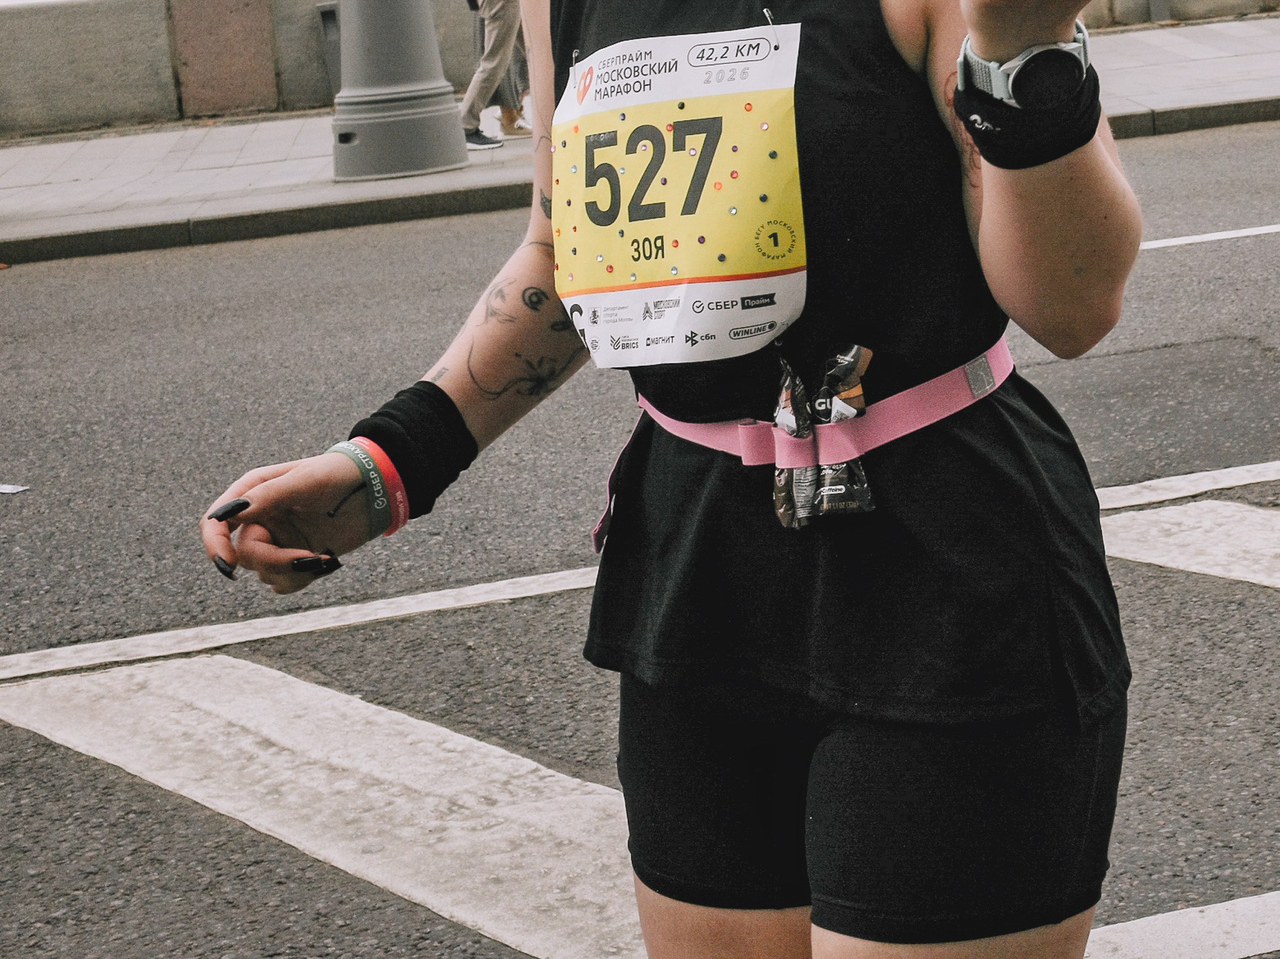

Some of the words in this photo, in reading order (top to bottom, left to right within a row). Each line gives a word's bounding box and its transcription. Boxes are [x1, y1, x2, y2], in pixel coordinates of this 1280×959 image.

[598, 49, 653, 70] СБЕРПРАЙМ
[696, 46, 728, 63] 42,2
[595, 57, 679, 86] МОСКОВСКИЙ
[703, 66, 750, 85] 2026
[594, 78, 652, 102] МАРАФОН
[584, 116, 723, 227] 527
[631, 235, 665, 262] ЗОЯ
[768, 232, 779, 247] 1
[707, 300, 738, 311] СБЕР
[744, 297, 770, 307] Прайм
[700, 333, 716, 341] сбп
[732, 325, 767, 338] WINLINE
[621, 342, 639, 350] BRICS
[370, 471, 383, 497] СБЕР
